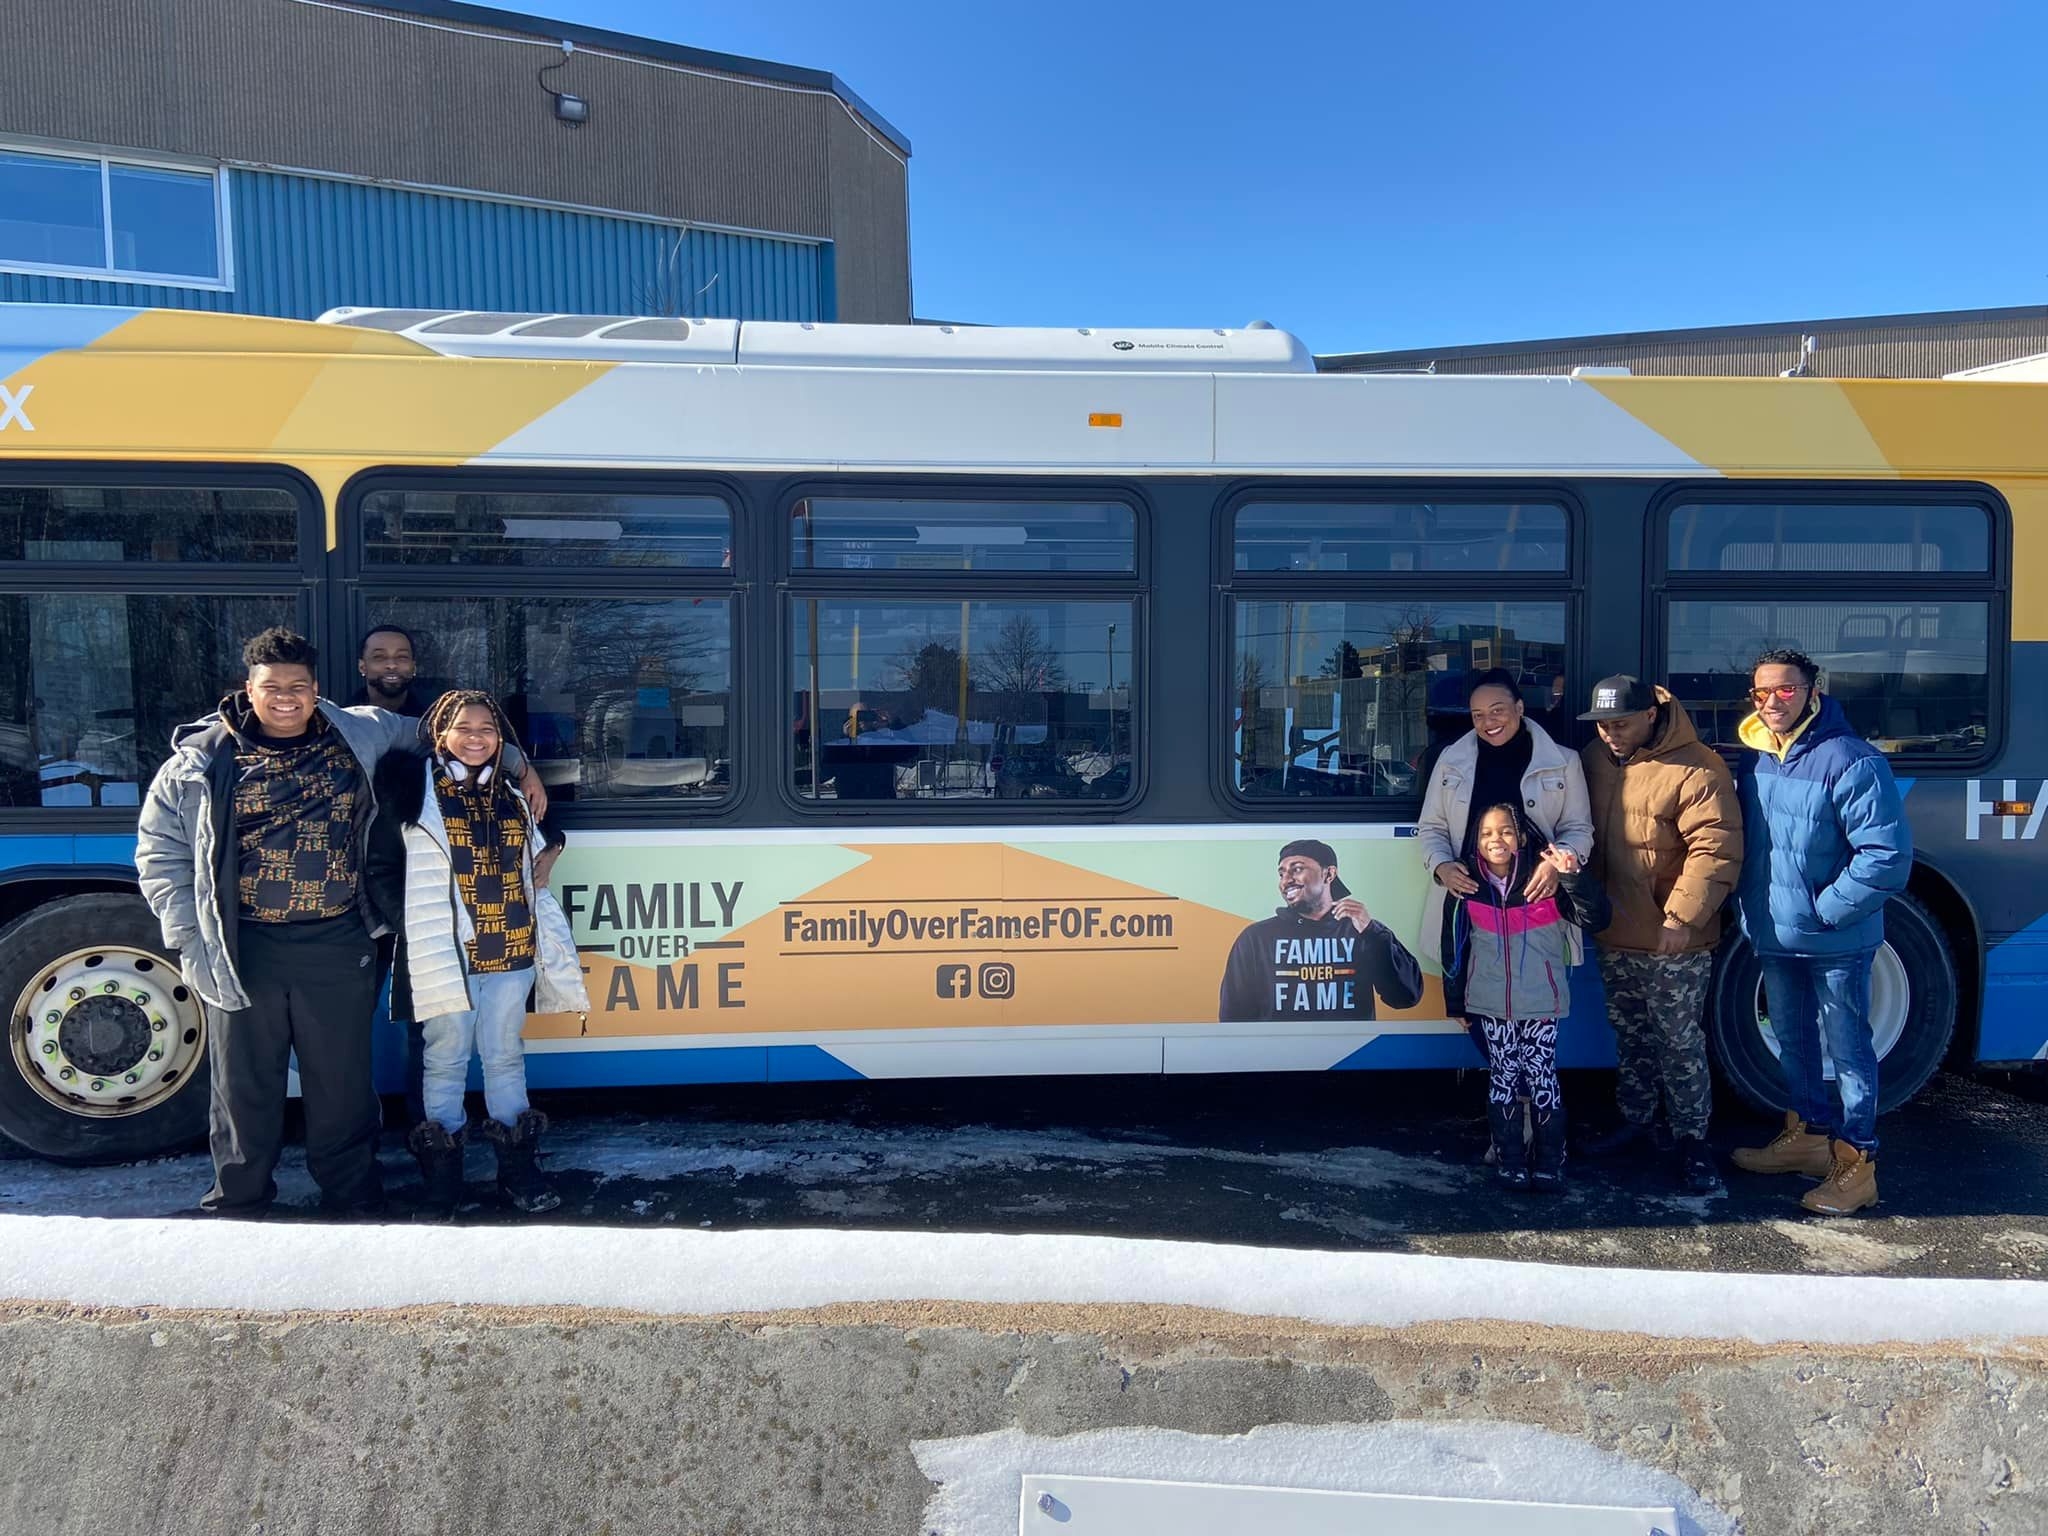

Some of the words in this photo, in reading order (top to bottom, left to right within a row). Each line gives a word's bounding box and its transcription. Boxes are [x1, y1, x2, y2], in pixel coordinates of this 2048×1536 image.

[0, 384, 35, 431] X
[445, 817, 470, 828] AMILY
[448, 834, 473, 847] AME
[463, 892, 478, 905] ME
[476, 903, 505, 915] FAMILY
[562, 881, 744, 931] FAMILY
[476, 920, 507, 935] FAME
[505, 925, 533, 942] FAMILY
[783, 907, 1173, 947] FamilyOverFameFOF.com
[620, 934, 689, 959] OVER
[1274, 937, 1355, 964] FAMILY
[1300, 966, 1333, 981] OVER
[580, 961, 746, 1012] AME
[1275, 981, 1355, 1011] FAME
